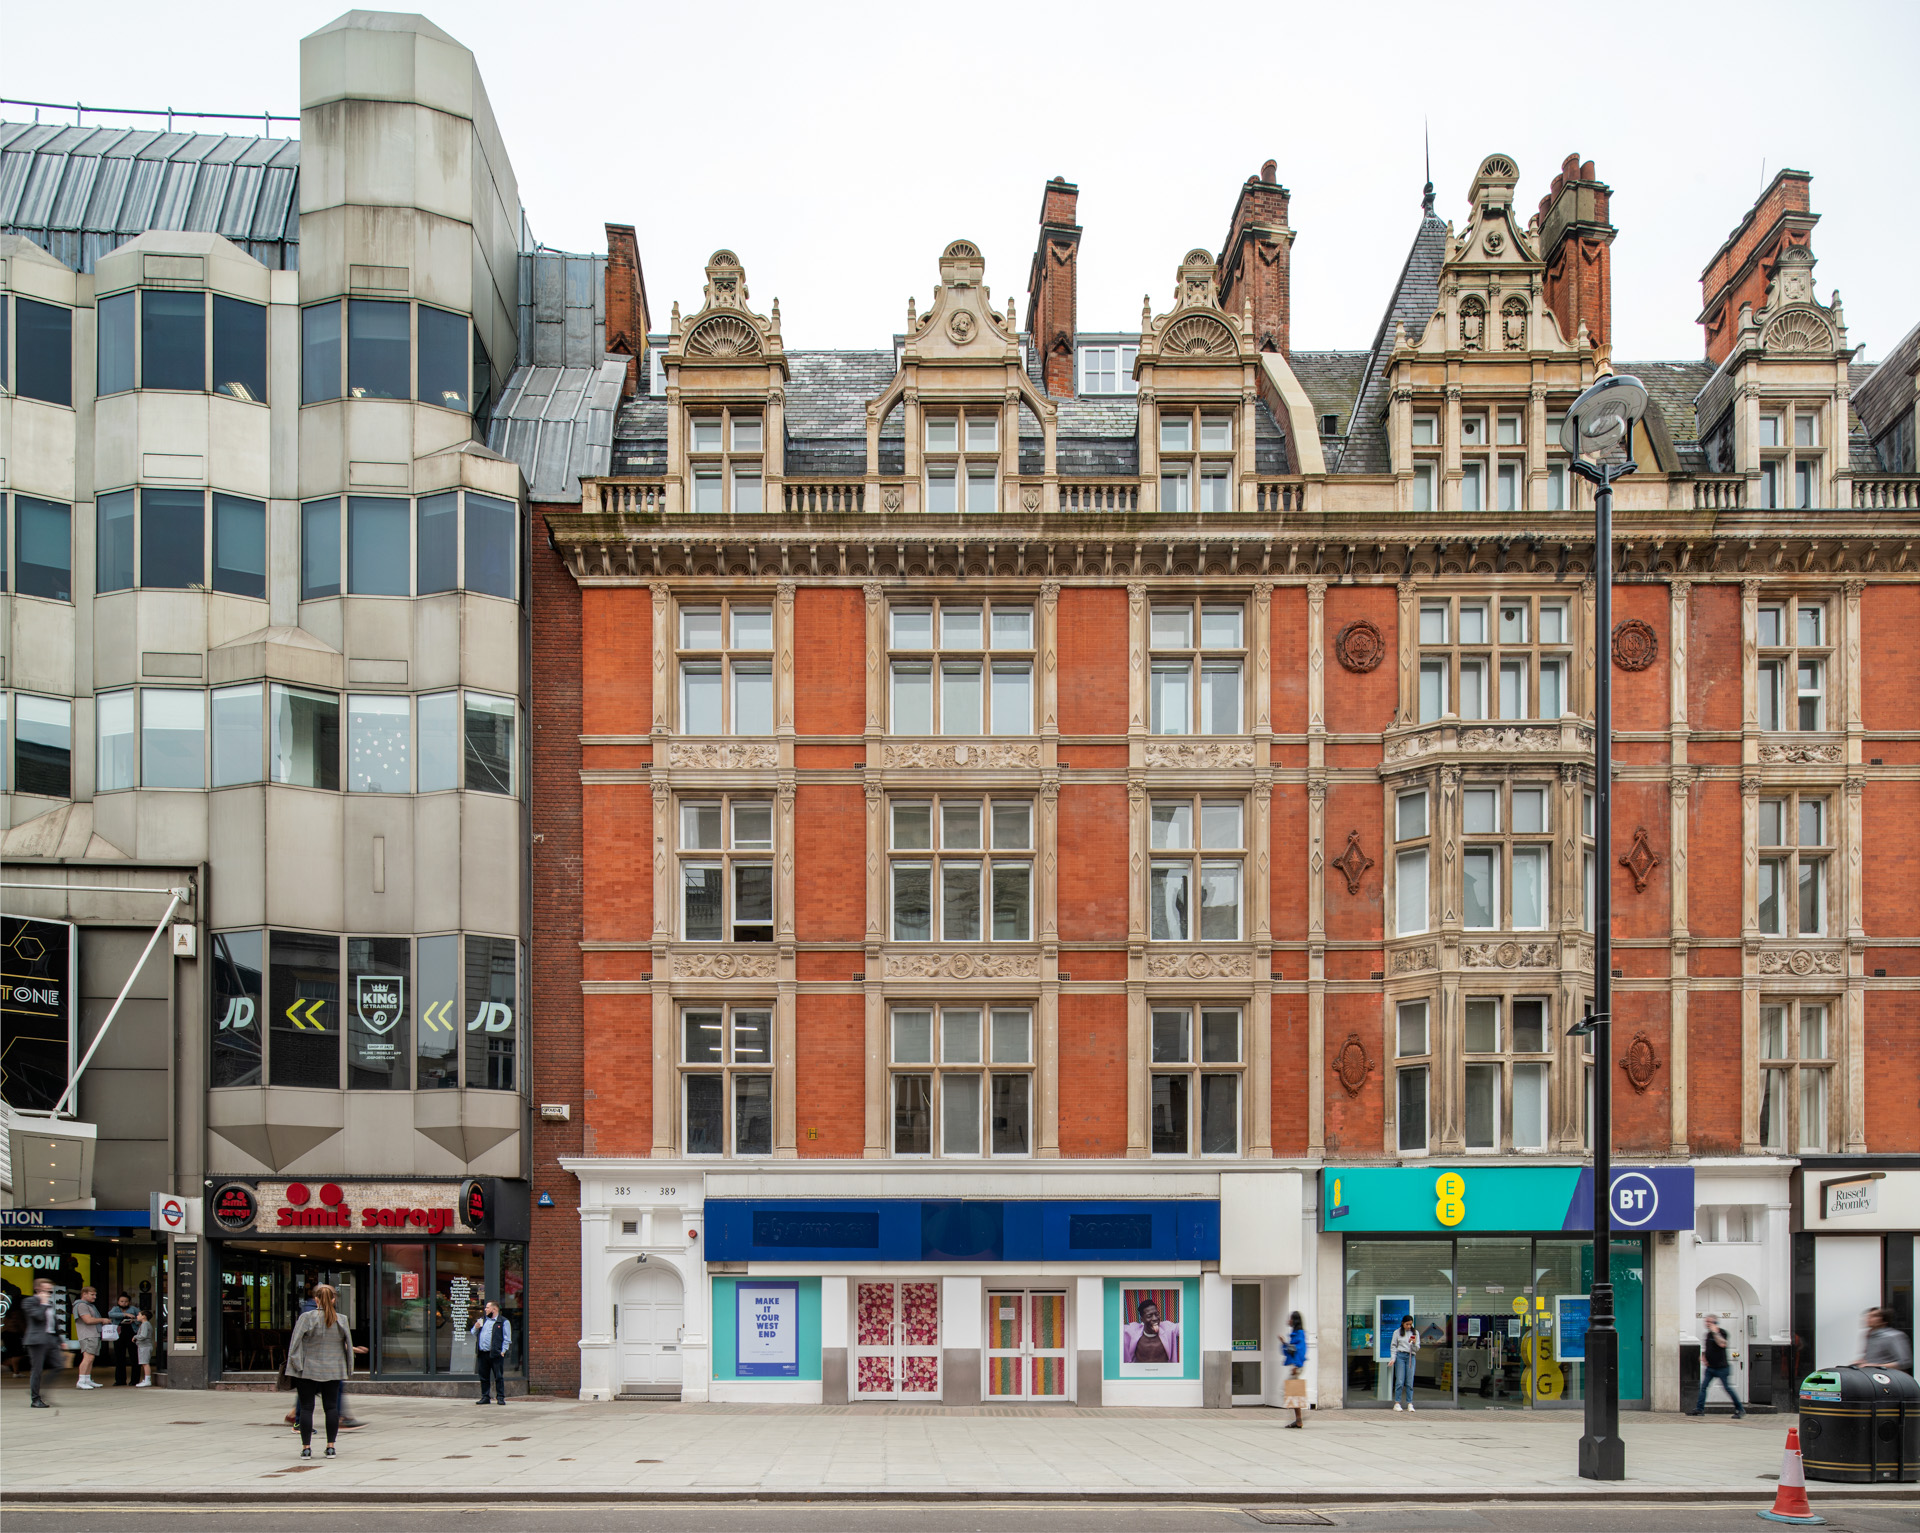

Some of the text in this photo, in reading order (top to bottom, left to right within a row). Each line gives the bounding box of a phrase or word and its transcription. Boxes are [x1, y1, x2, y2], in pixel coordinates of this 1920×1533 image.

[363, 993, 397, 1004] KING
[219, 997, 255, 1030] JD
[467, 1001, 512, 1032] JD
[614, 1186, 630, 1196] 385
[660, 1187, 676, 1196] 389
[1836, 1186, 1866, 1200] Russell
[1620, 1189, 1647, 1209] BT
[1, 1239, 54, 1248] cDonald's
